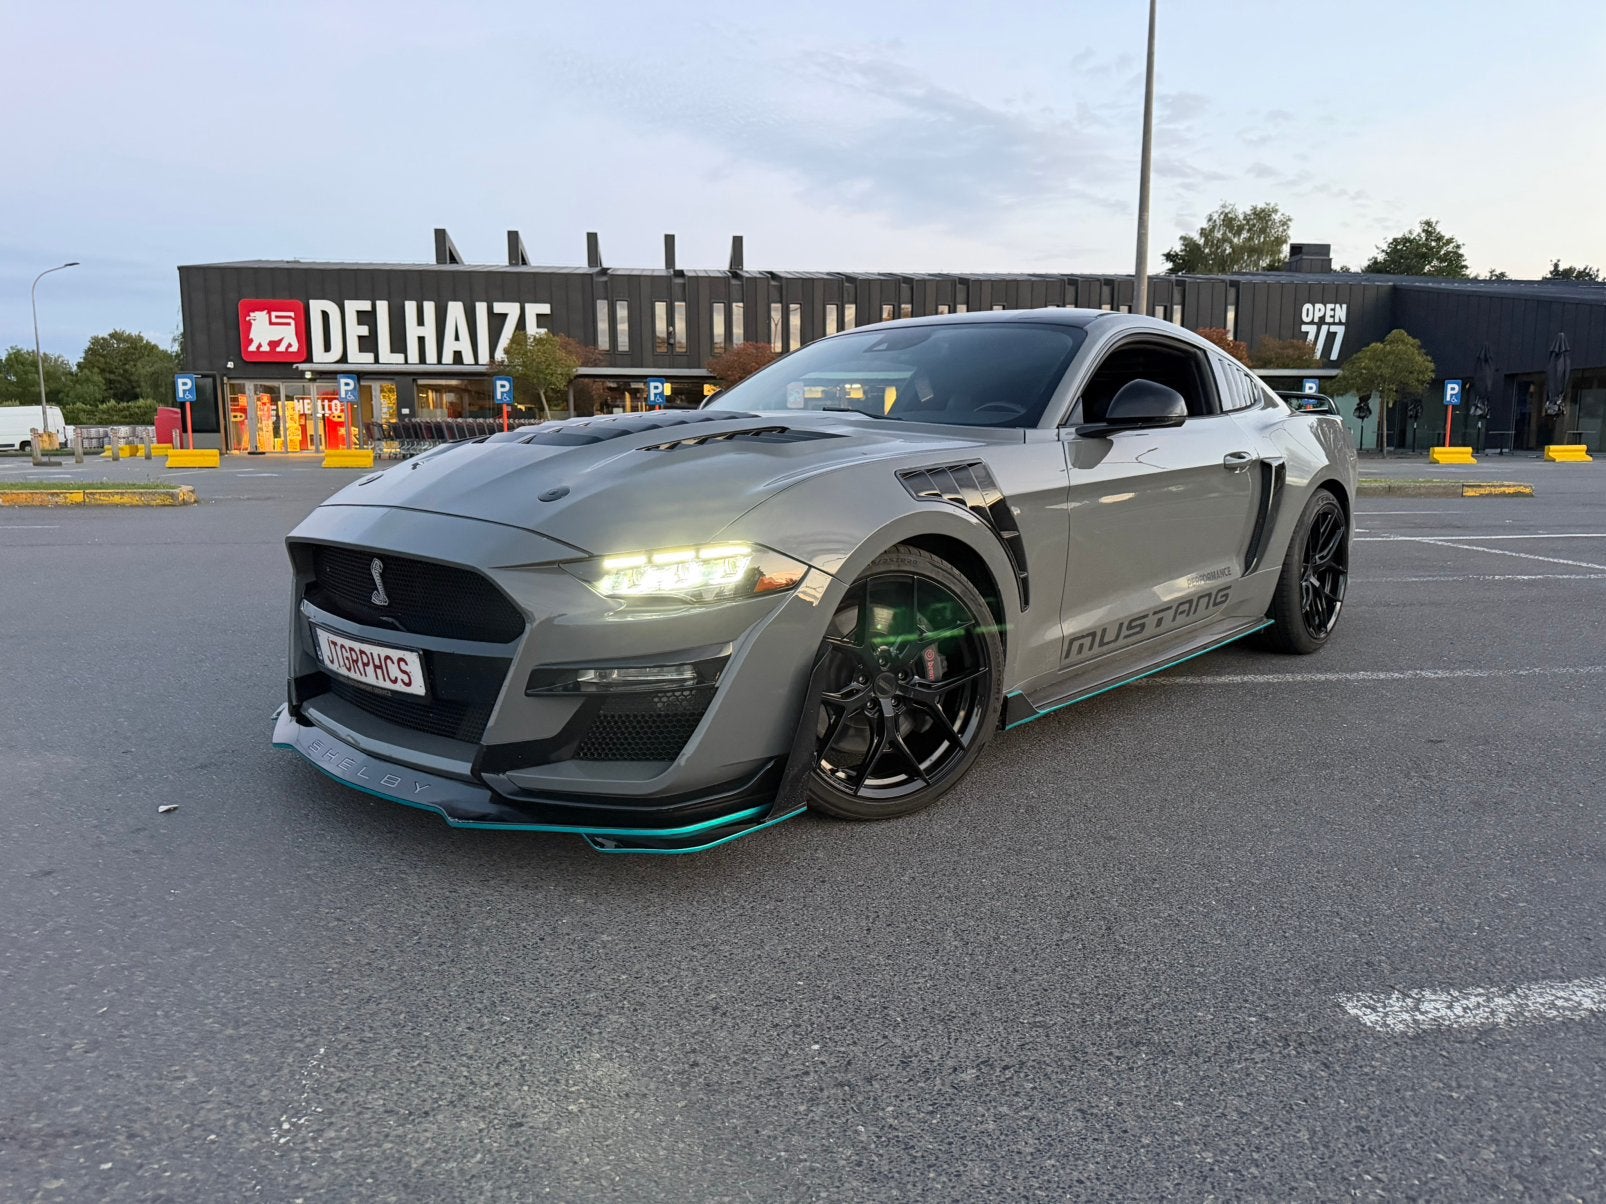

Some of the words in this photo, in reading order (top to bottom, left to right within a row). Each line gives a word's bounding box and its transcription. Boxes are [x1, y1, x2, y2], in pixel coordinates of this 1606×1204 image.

[1301, 303, 1347, 323] OPEN
[1301, 324, 1346, 361] 7/7
[177, 378, 192, 398] P
[340, 378, 354, 398] P
[495, 380, 510, 400] P
[649, 381, 663, 401] P
[1305, 382, 1317, 394] P
[1446, 383, 1459, 401] P
[295, 399, 341, 415] HELLO
[1186, 566, 1232, 588] PERFORMANCE
[1063, 585, 1232, 660] MUSTANG
[327, 638, 412, 688] JTGRPHCS
[308, 740, 432, 794] SHELBY
